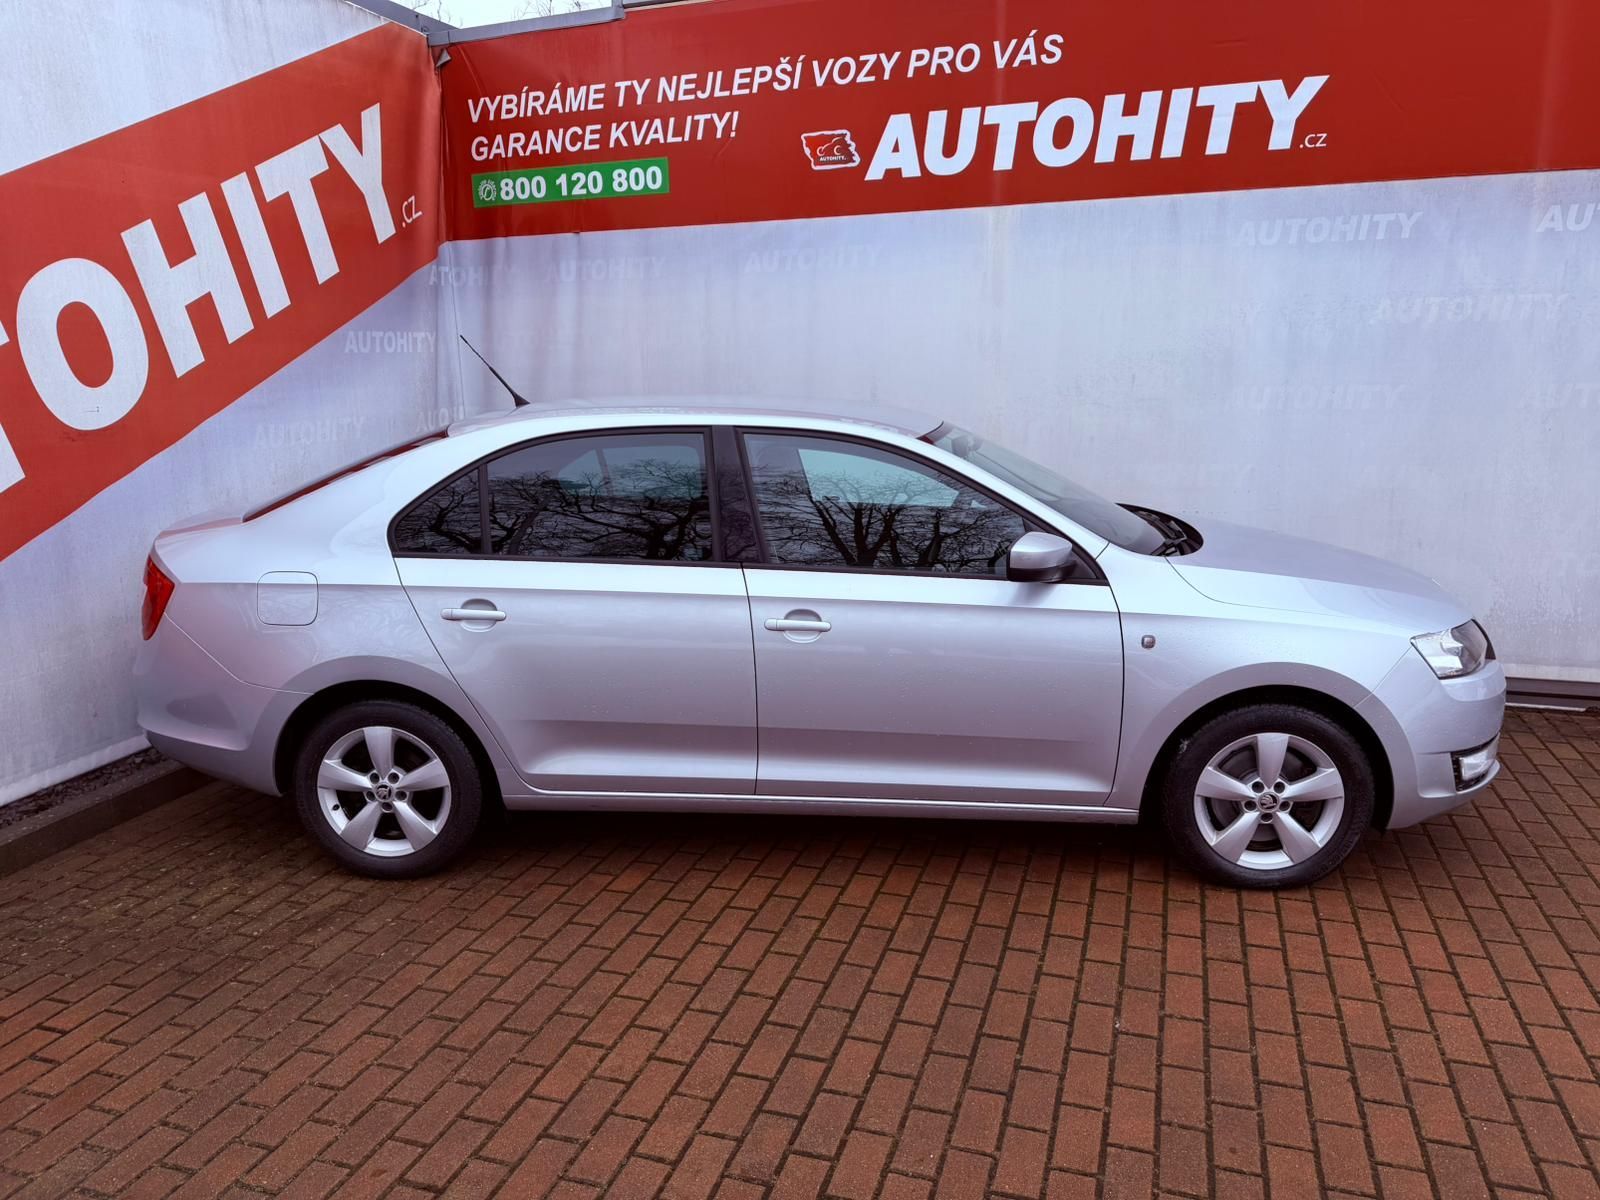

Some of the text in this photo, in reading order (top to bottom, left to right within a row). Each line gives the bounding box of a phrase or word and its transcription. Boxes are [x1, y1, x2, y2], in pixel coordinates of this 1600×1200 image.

[468, 29, 1065, 123] VYBÍRÁME TY NEJLEPŠÍ VOZY PRO VÁS
[471, 110, 739, 161] GARANCE KVALITY!
[864, 74, 1330, 182] AUTOHITY
[500, 175, 547, 201] 800
[555, 171, 604, 197] 120
[612, 165, 663, 193] 800
[1236, 211, 1423, 247] AUTOHITY
[344, 330, 436, 354] AUTOHITY
